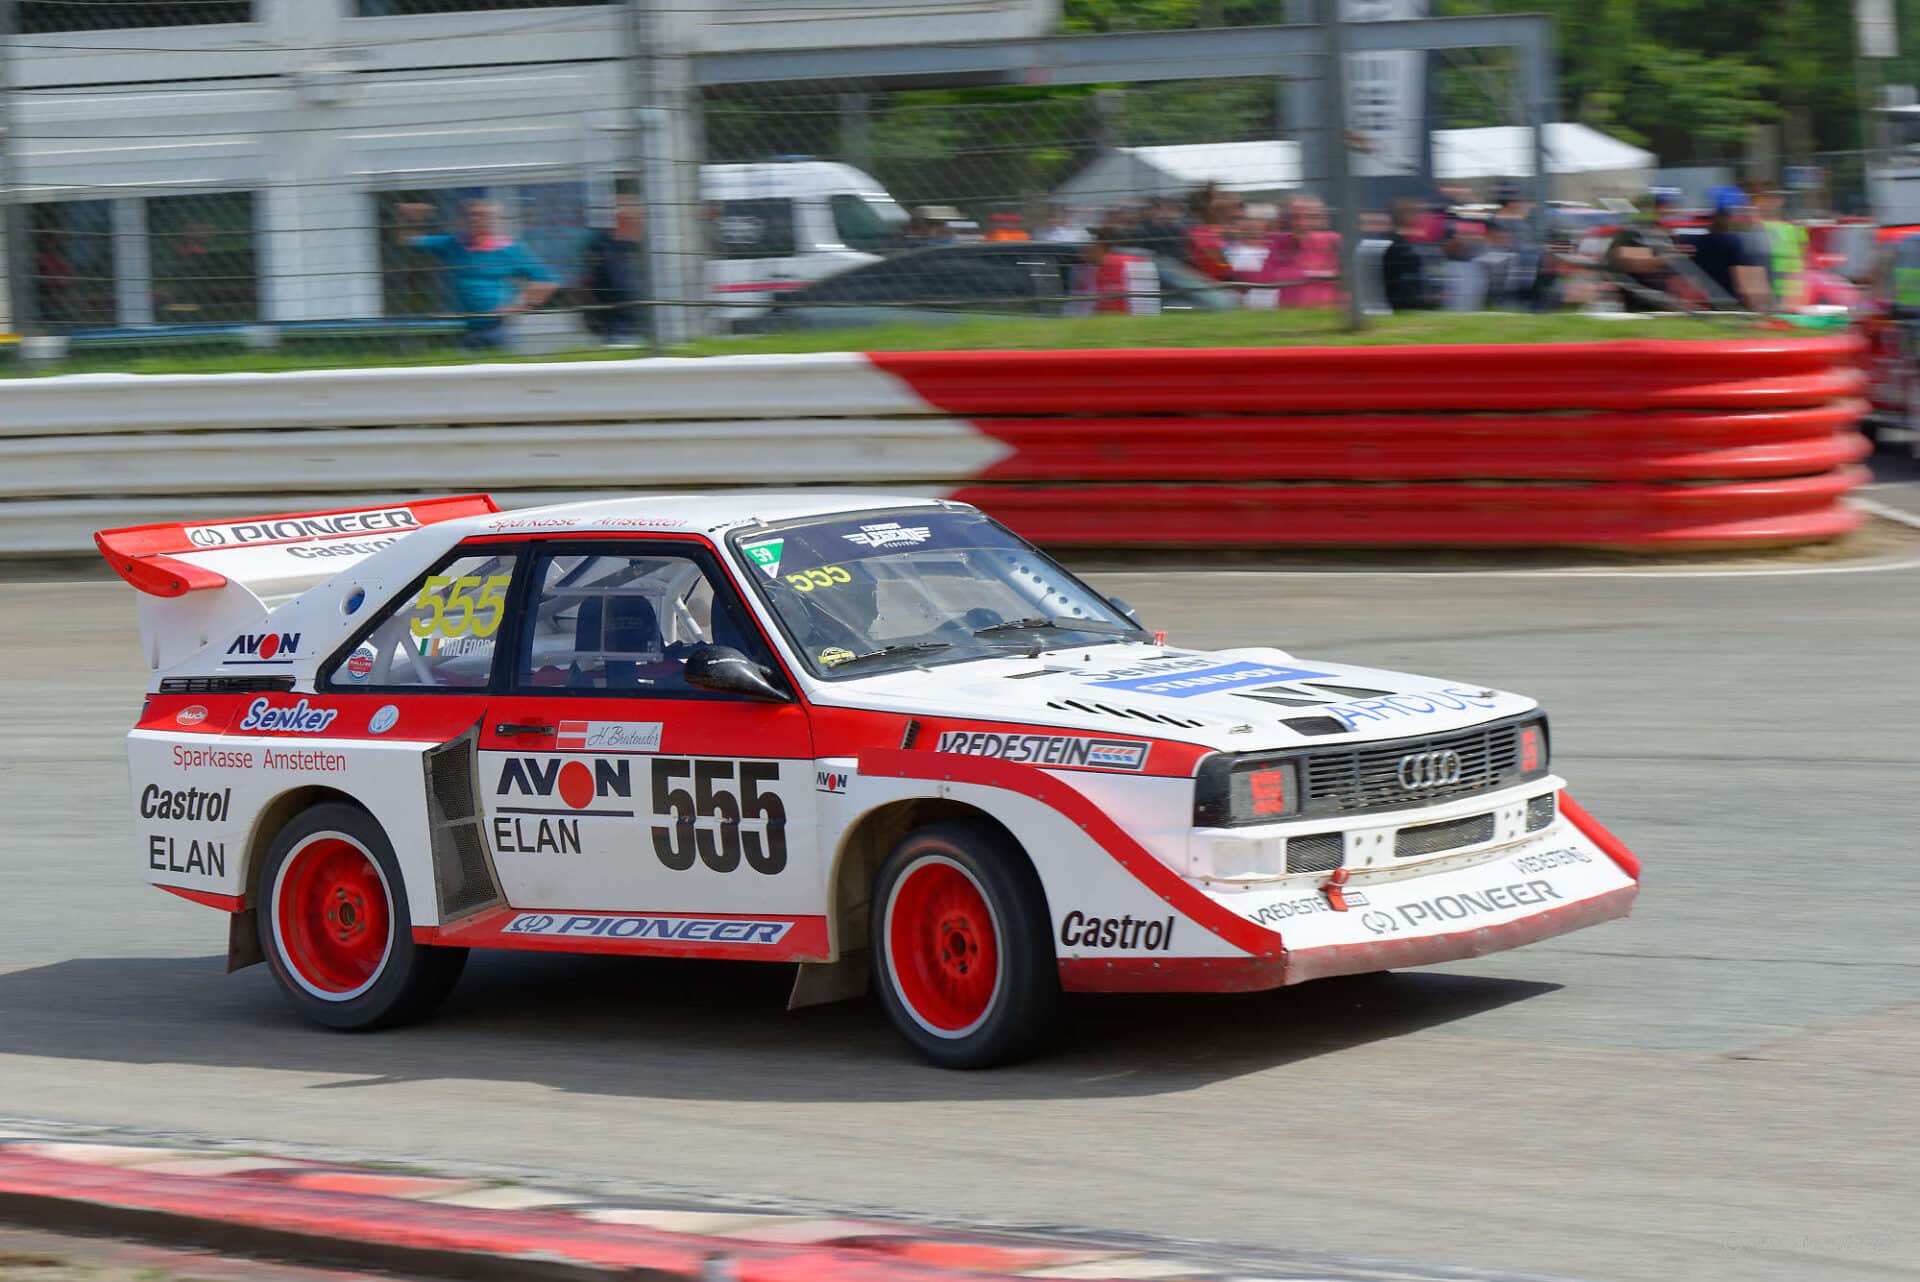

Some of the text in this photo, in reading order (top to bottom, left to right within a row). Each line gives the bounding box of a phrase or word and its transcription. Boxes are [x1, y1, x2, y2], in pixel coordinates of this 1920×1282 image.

[232, 510, 414, 541] PIONEER
[785, 566, 851, 592] 555
[411, 575, 512, 638] 555
[226, 632, 301, 660] AVON
[242, 698, 337, 731] Senker
[173, 745, 346, 771] Sparkasse Amstetten
[941, 732, 1091, 765] VREDESTEIN
[496, 758, 632, 809] AVON
[817, 771, 848, 790] AVON
[141, 783, 232, 822] Castrol
[651, 759, 787, 875] 555
[494, 817, 582, 854] ELAN
[150, 835, 225, 877] ELAN
[1396, 880, 1564, 926] PIONEER
[557, 916, 784, 943] PIONEER
[1061, 910, 1175, 950] Castrol
